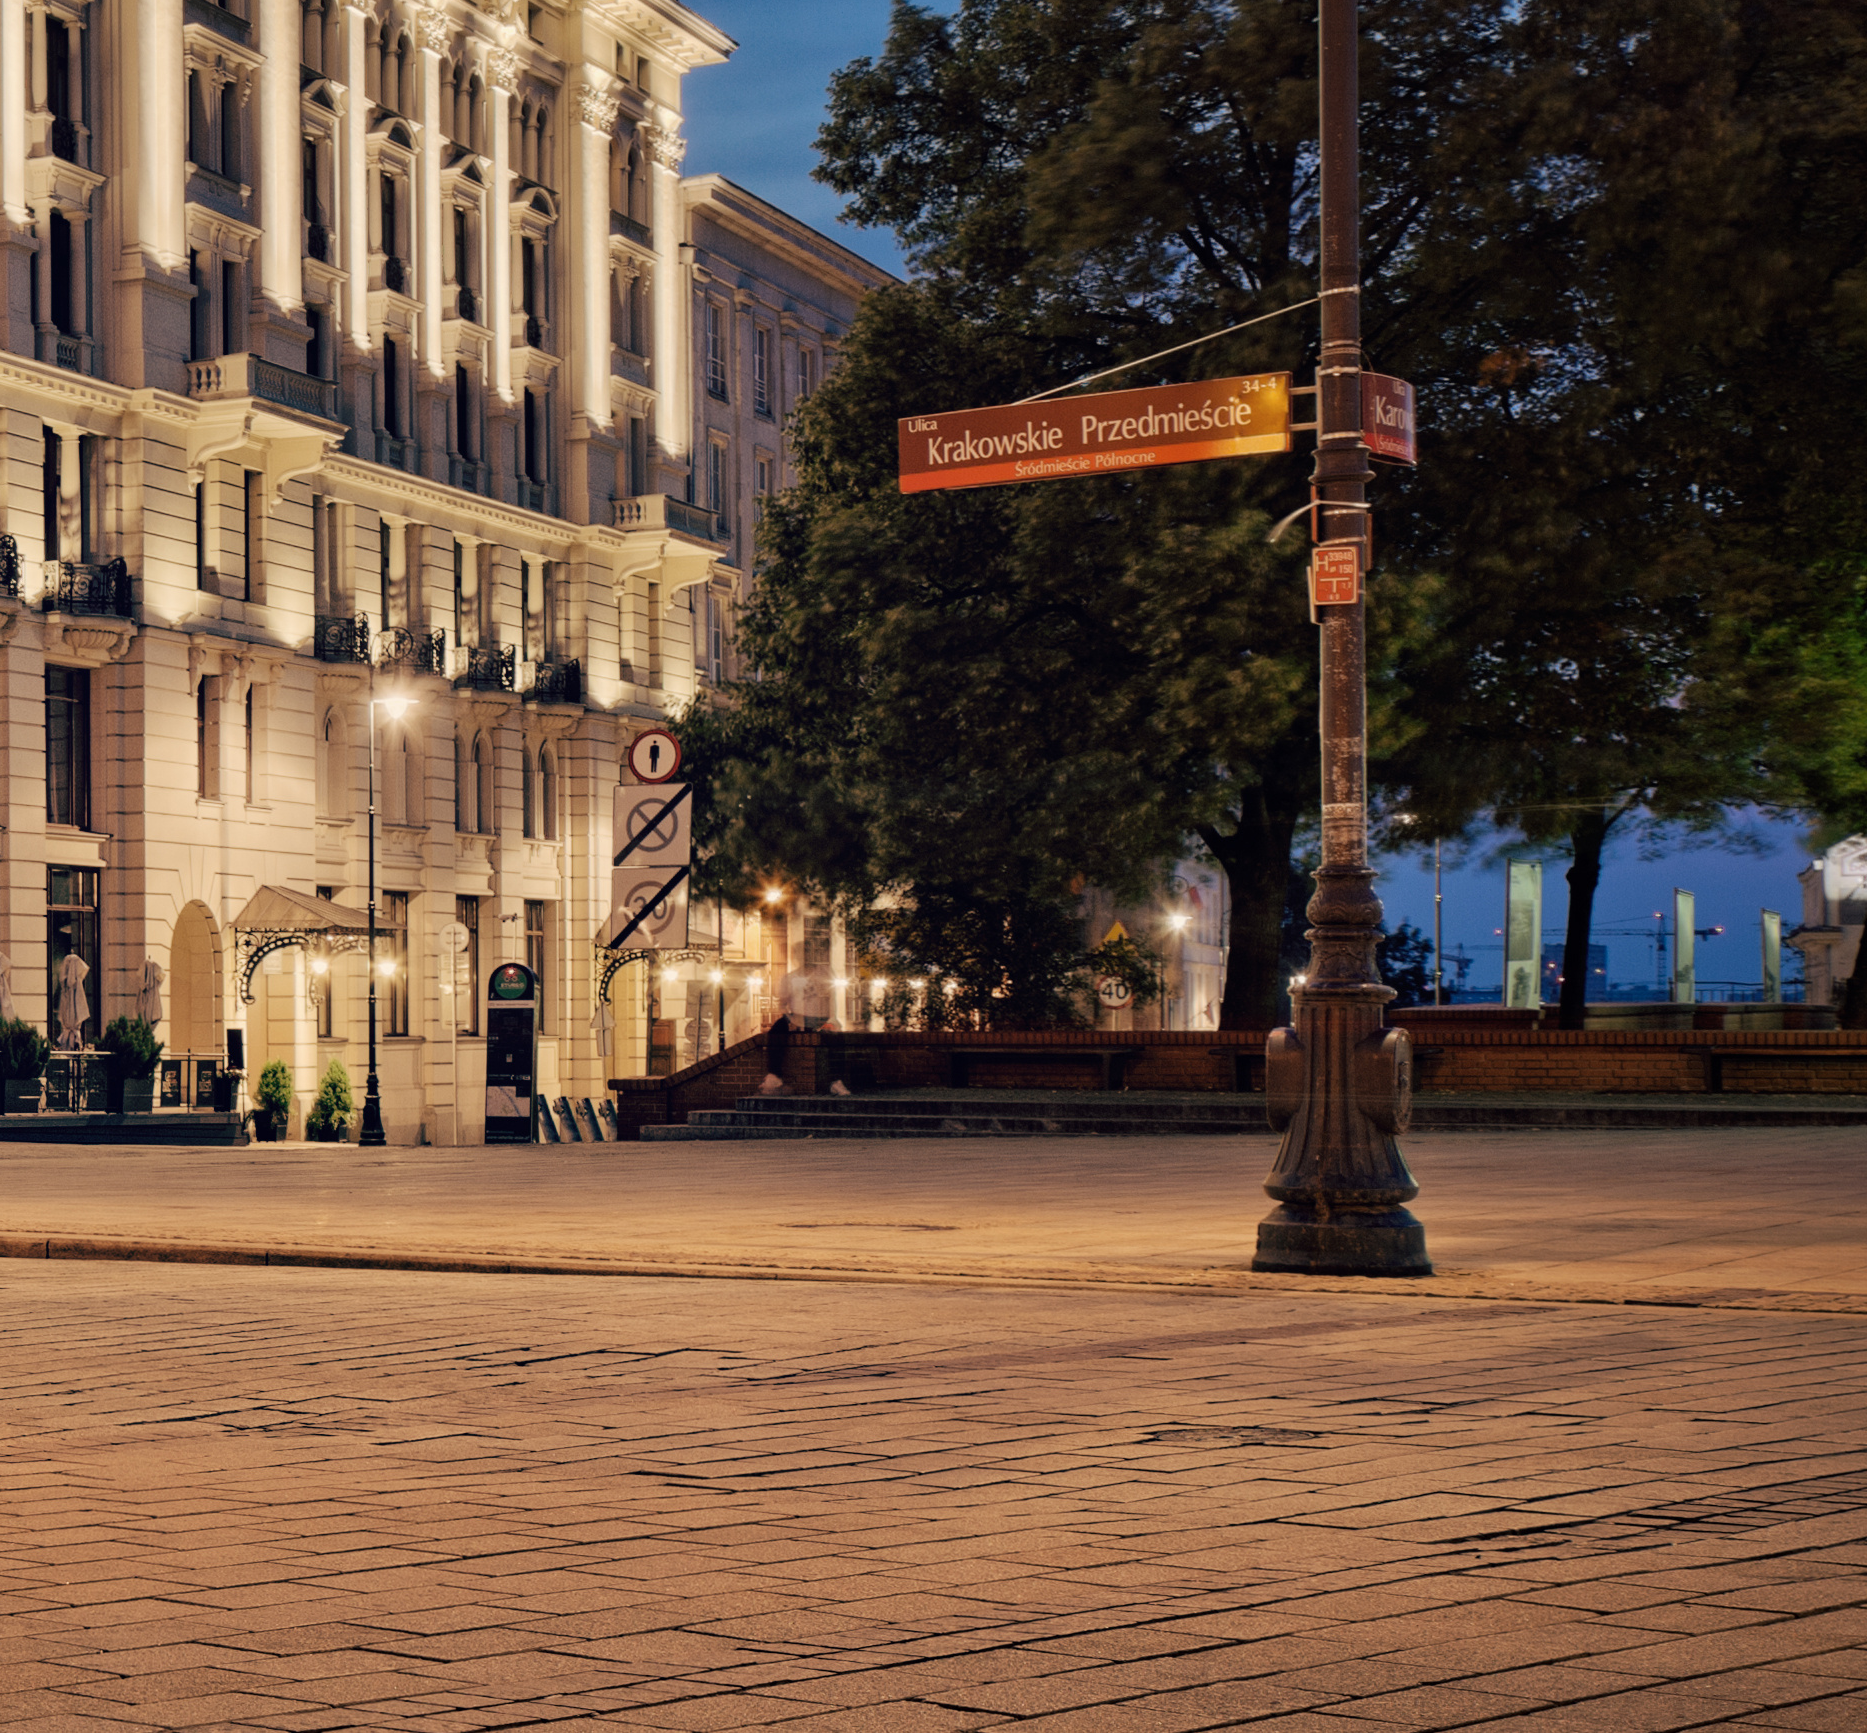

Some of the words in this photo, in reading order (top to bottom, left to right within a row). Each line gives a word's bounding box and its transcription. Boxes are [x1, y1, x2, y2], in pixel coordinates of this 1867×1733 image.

[1242, 376, 1278, 394] 34-4
[908, 418, 939, 434] Ulica
[927, 420, 1064, 466] Krakowskie
[1081, 396, 1252, 445] Przedmieście
[1014, 455, 1091, 478] Śródmieście
[1095, 450, 1156, 469] Północne
[1316, 554, 1328, 571] H
[1101, 982, 1129, 1000] 40
